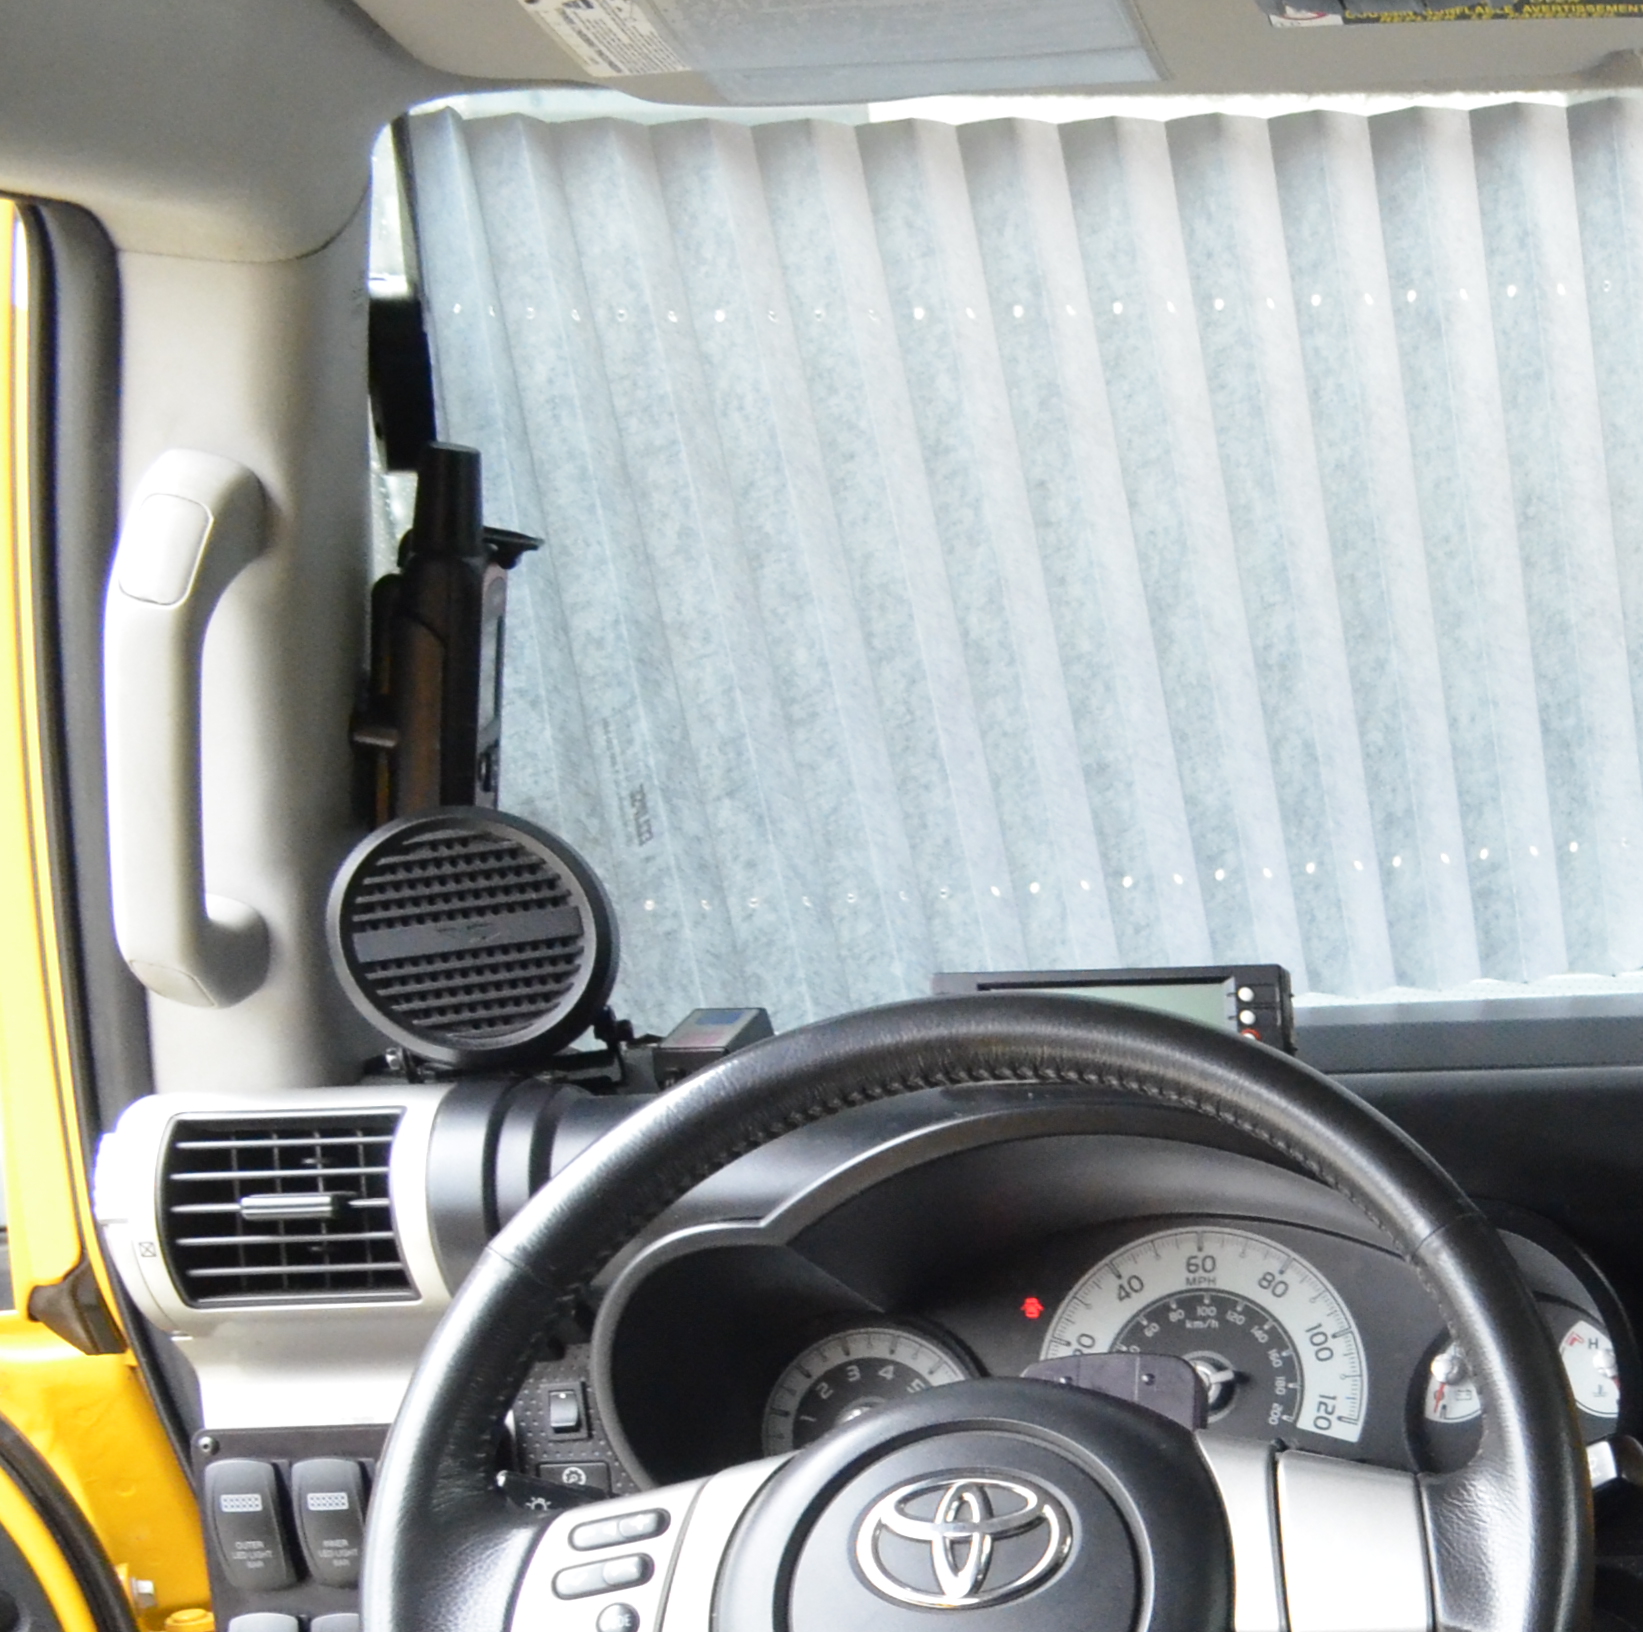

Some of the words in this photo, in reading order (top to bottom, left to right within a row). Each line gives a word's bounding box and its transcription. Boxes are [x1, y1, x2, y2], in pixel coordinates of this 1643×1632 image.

[1185, 1255, 1217, 1274] 60
[1116, 1275, 1145, 1303] 40
[1185, 1276, 1217, 1287] MPH
[1257, 1271, 1290, 1299] 80
[1196, 1305, 1217, 1318] 100
[1225, 1309, 1246, 1326] 120
[1185, 1318, 1220, 1330] km/h
[1305, 1323, 1334, 1363] 100
[1588, 1338, 1599, 1349] H
[845, 1365, 861, 1382] 3
[878, 1365, 895, 1381] 4
[815, 1382, 834, 1400] 2
[906, 1378, 926, 1394] 5
[1313, 1393, 1337, 1431] 120
[234, 1540, 265, 1550] OUTER
